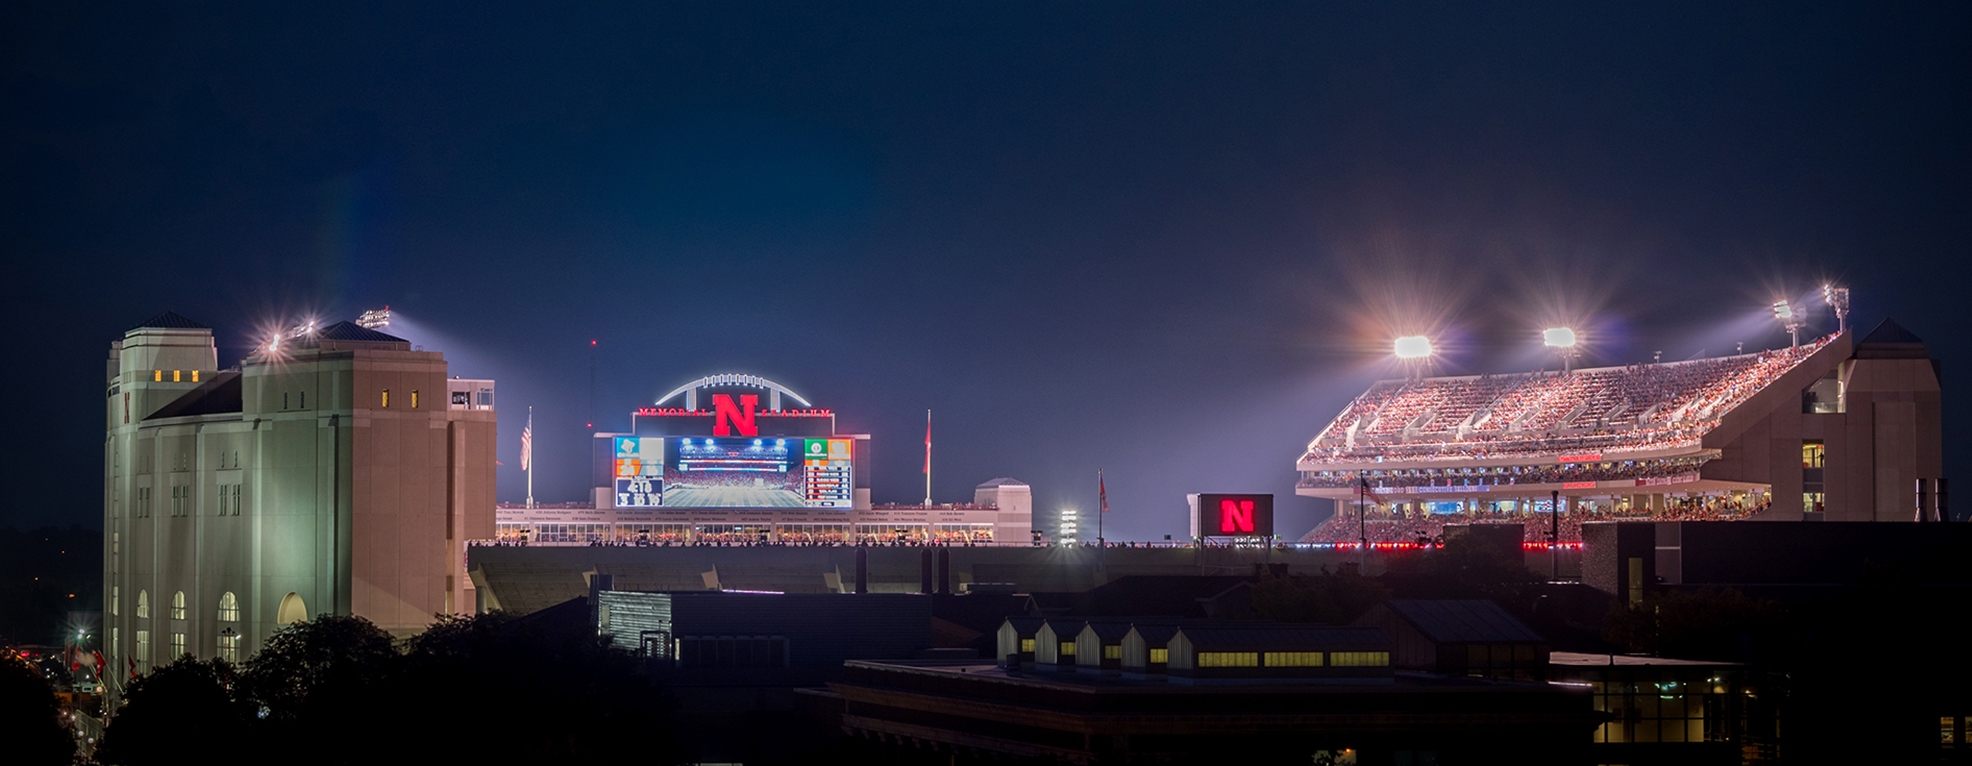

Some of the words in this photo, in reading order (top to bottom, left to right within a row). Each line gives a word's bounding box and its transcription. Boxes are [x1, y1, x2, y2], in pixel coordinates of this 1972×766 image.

[639, 408, 708, 417] MEMORIAL
[713, 394, 758, 436] N
[762, 409, 831, 418] STADIUM
[1221, 500, 1254, 533] N
